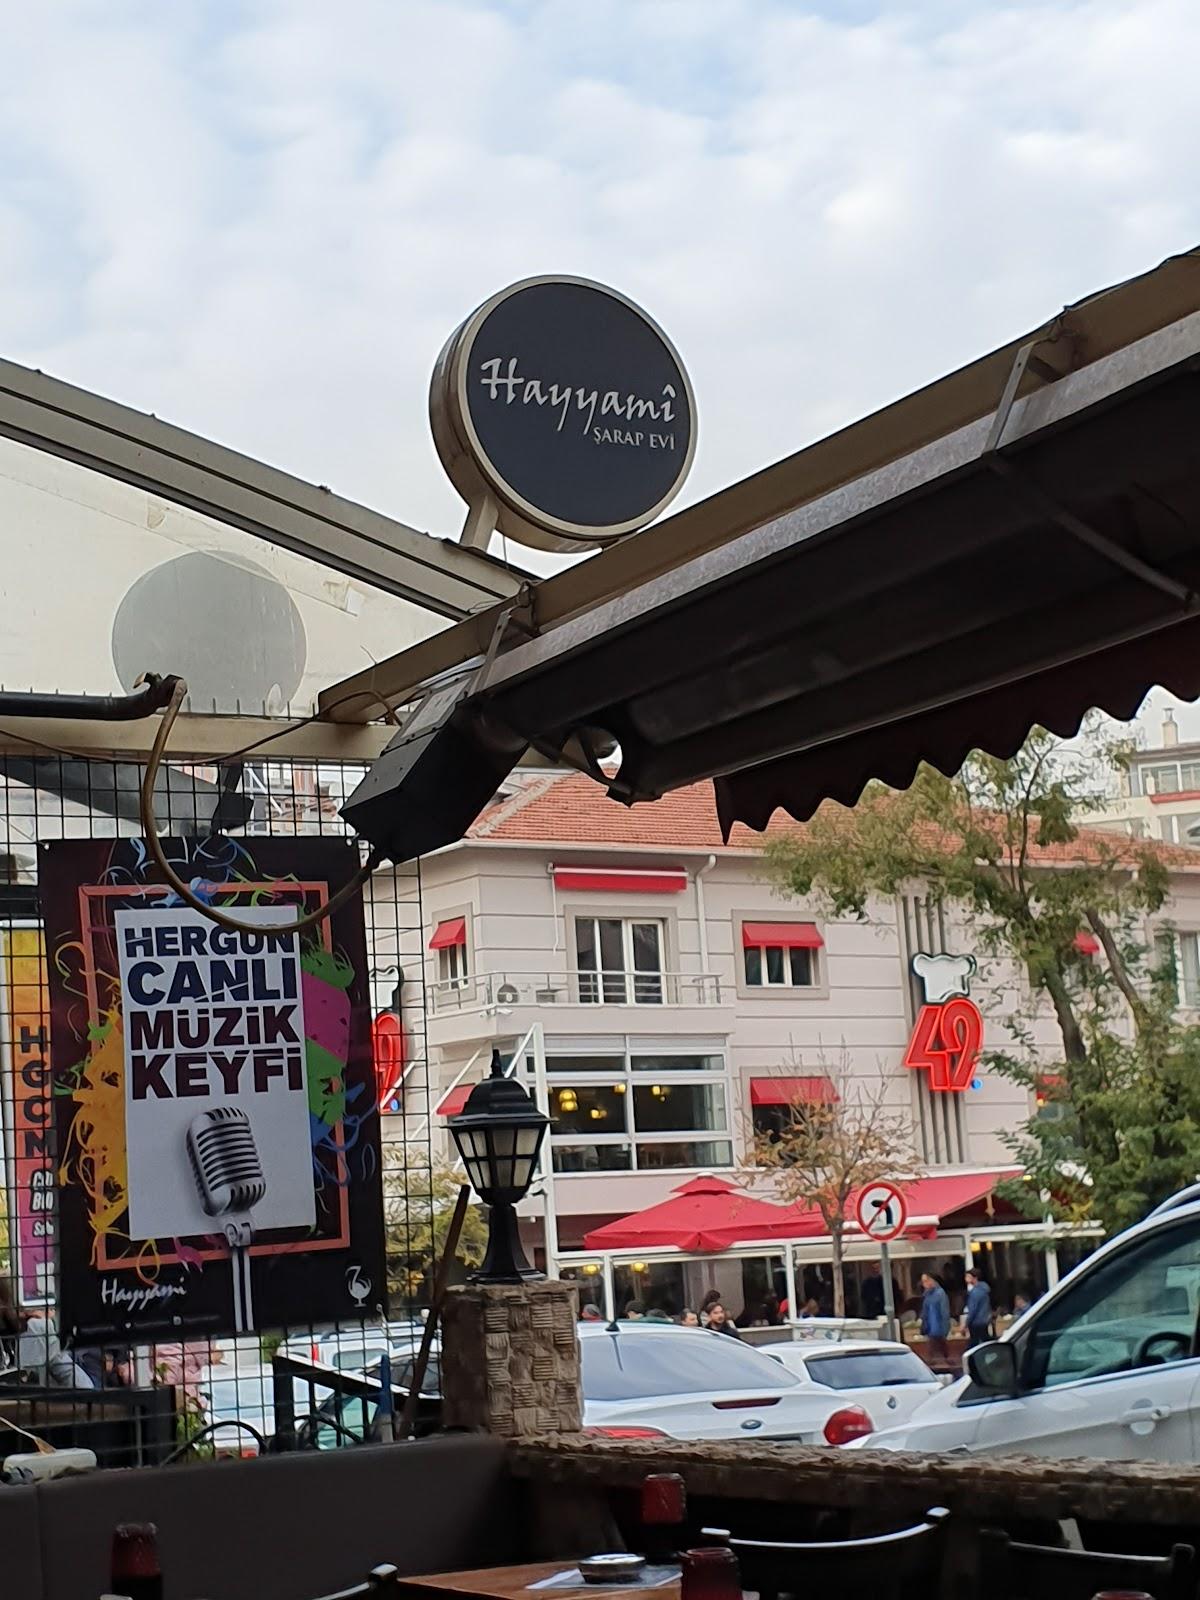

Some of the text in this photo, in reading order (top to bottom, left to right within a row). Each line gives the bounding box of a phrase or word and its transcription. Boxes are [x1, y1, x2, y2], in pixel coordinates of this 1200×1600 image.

[480, 357, 677, 436] Hayyamî
[593, 426, 644, 446] ŞARAP
[127, 957, 298, 1006] CANLI
[904, 997, 984, 1091] 49
